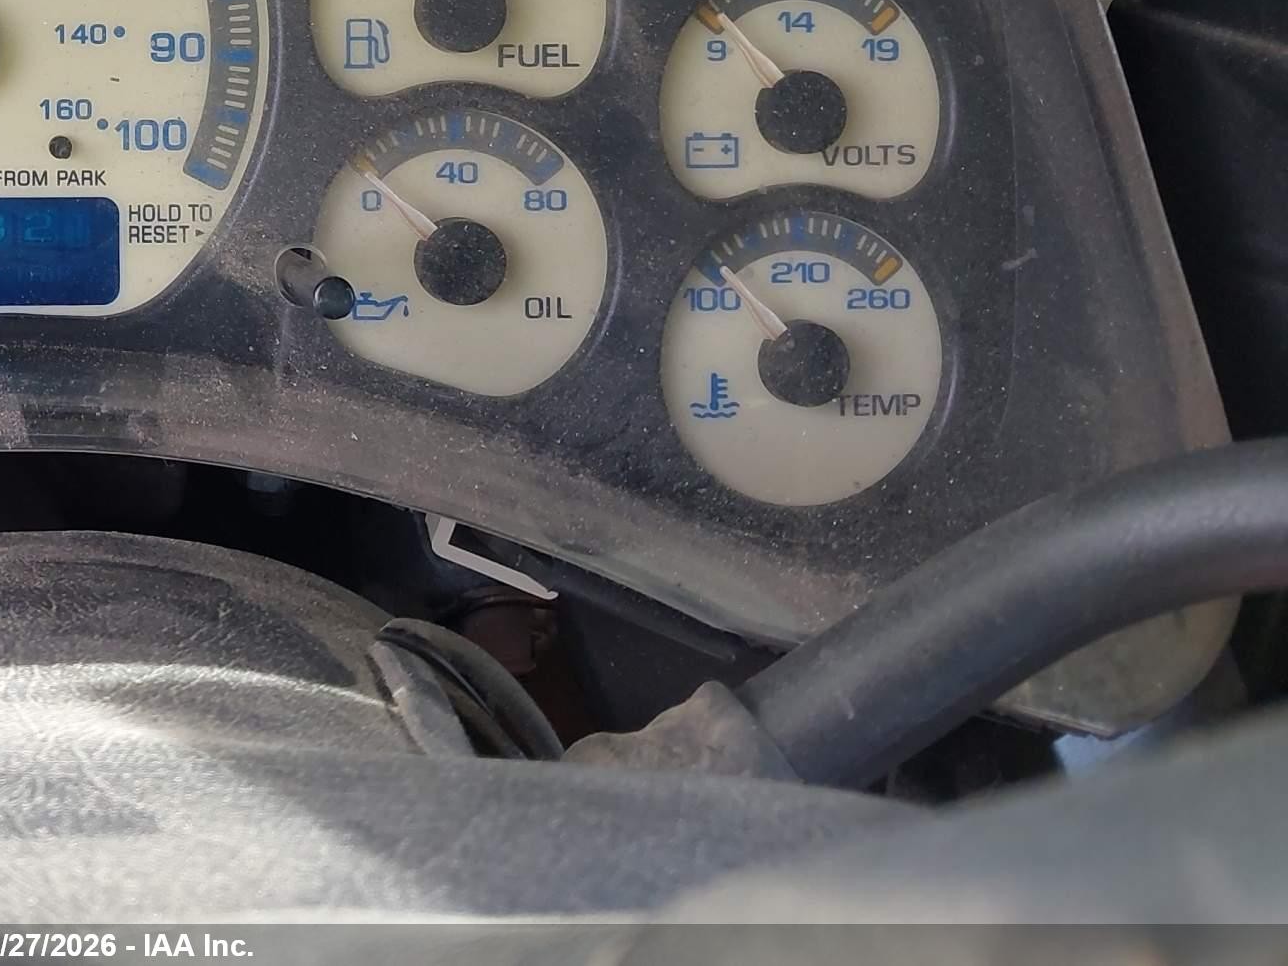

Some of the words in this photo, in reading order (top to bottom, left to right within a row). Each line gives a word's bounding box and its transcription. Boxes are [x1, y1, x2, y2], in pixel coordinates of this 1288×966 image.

[778, 12, 815, 32] 14
[55, 24, 106, 44] 140
[151, 33, 205, 62] 90
[498, 44, 580, 67] FUEL
[707, 41, 726, 61] 9
[862, 39, 899, 61] 19
[40, 99, 92, 120] 160
[115, 117, 187, 150] 100
[821, 145, 916, 166] VOLTS
[57, 170, 106, 186] PARK
[436, 162, 478, 183] 40
[362, 190, 381, 211] 0
[524, 190, 567, 211] 80
[129, 204, 180, 222] HOLD
[188, 204, 212, 222] TO
[129, 226, 189, 243] RESET
[772, 263, 830, 283] 210
[525, 297, 572, 318] OIL
[683, 288, 742, 311] 100
[847, 289, 910, 309] 260
[836, 394, 921, 415] TEMP
